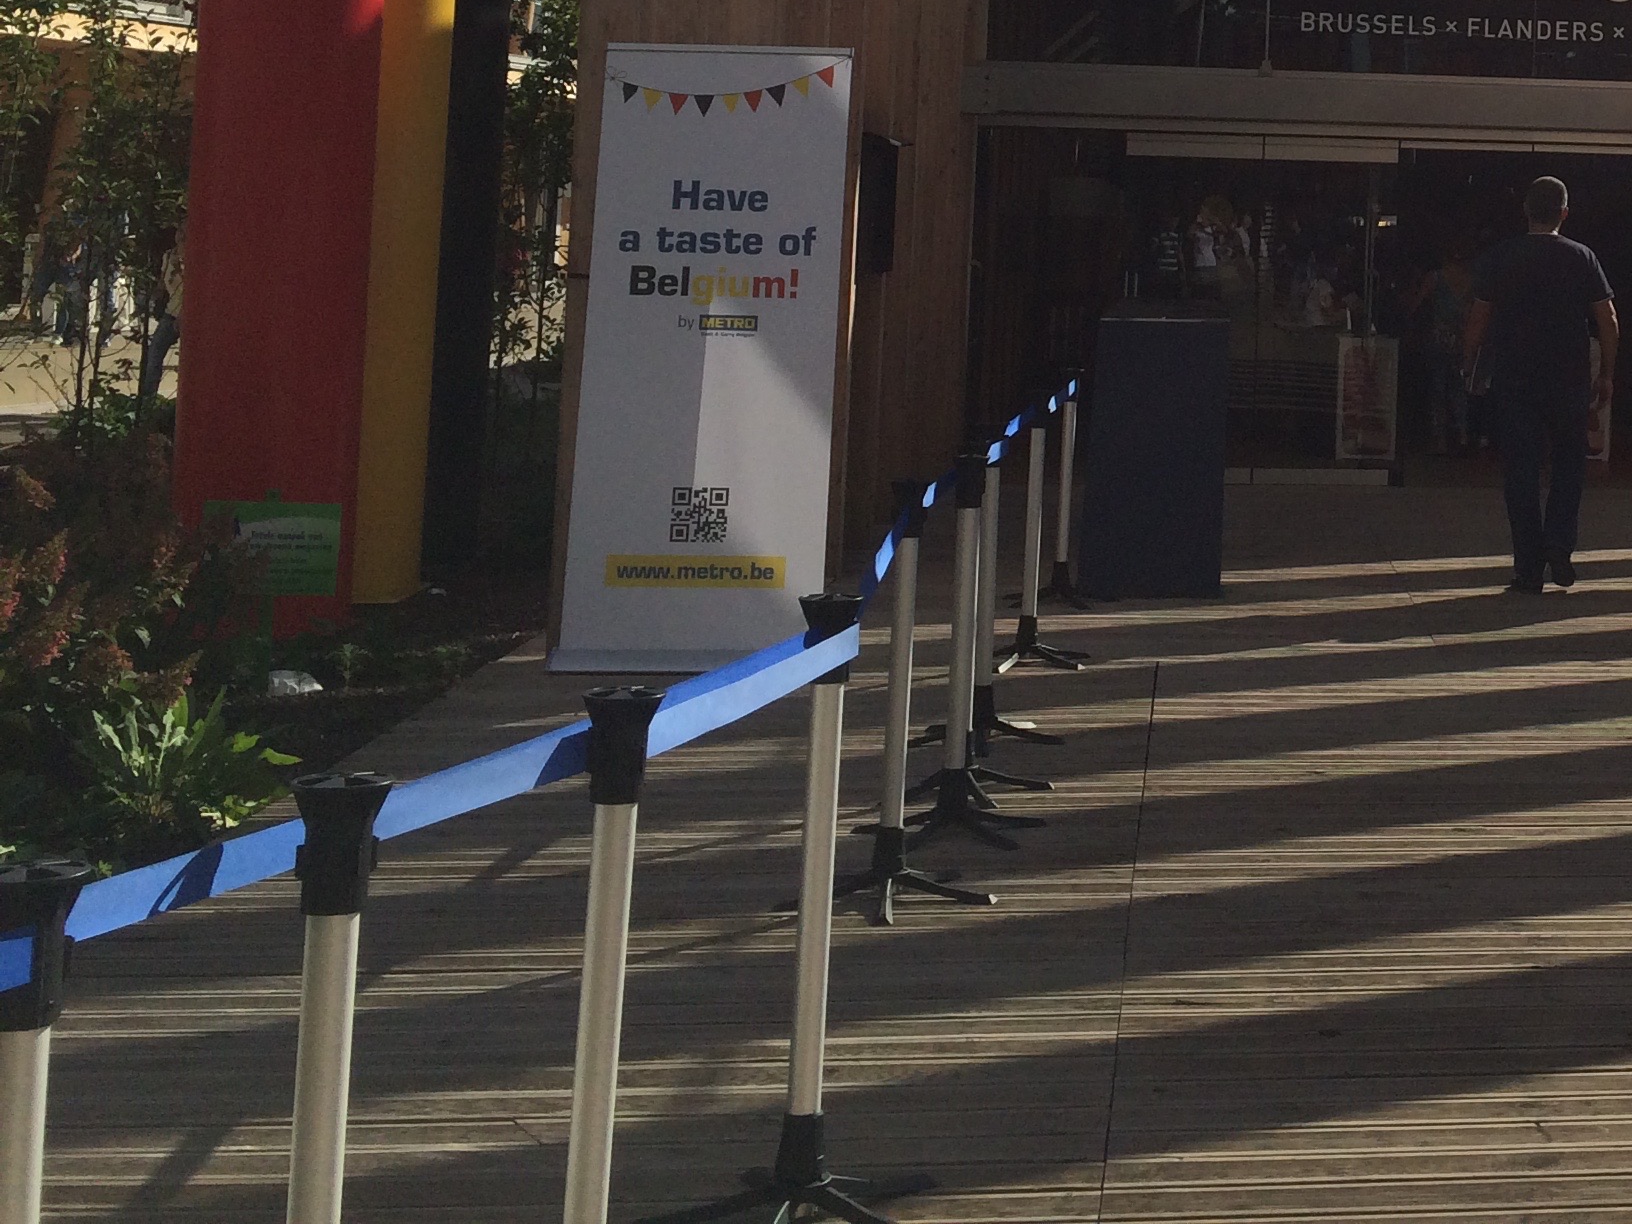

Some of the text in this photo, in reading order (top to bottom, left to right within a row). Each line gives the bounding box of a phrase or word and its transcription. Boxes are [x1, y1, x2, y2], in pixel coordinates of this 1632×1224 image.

[1299, 11, 1437, 37] BRUSSELS
[1466, 17, 1604, 42] FLANDERS
[672, 179, 769, 213] Have
[617, 225, 817, 257] a taste of
[628, 265, 799, 307] Belgium!
[677, 314, 756, 331] by METRO
[615, 561, 776, 583] www.metro.be
